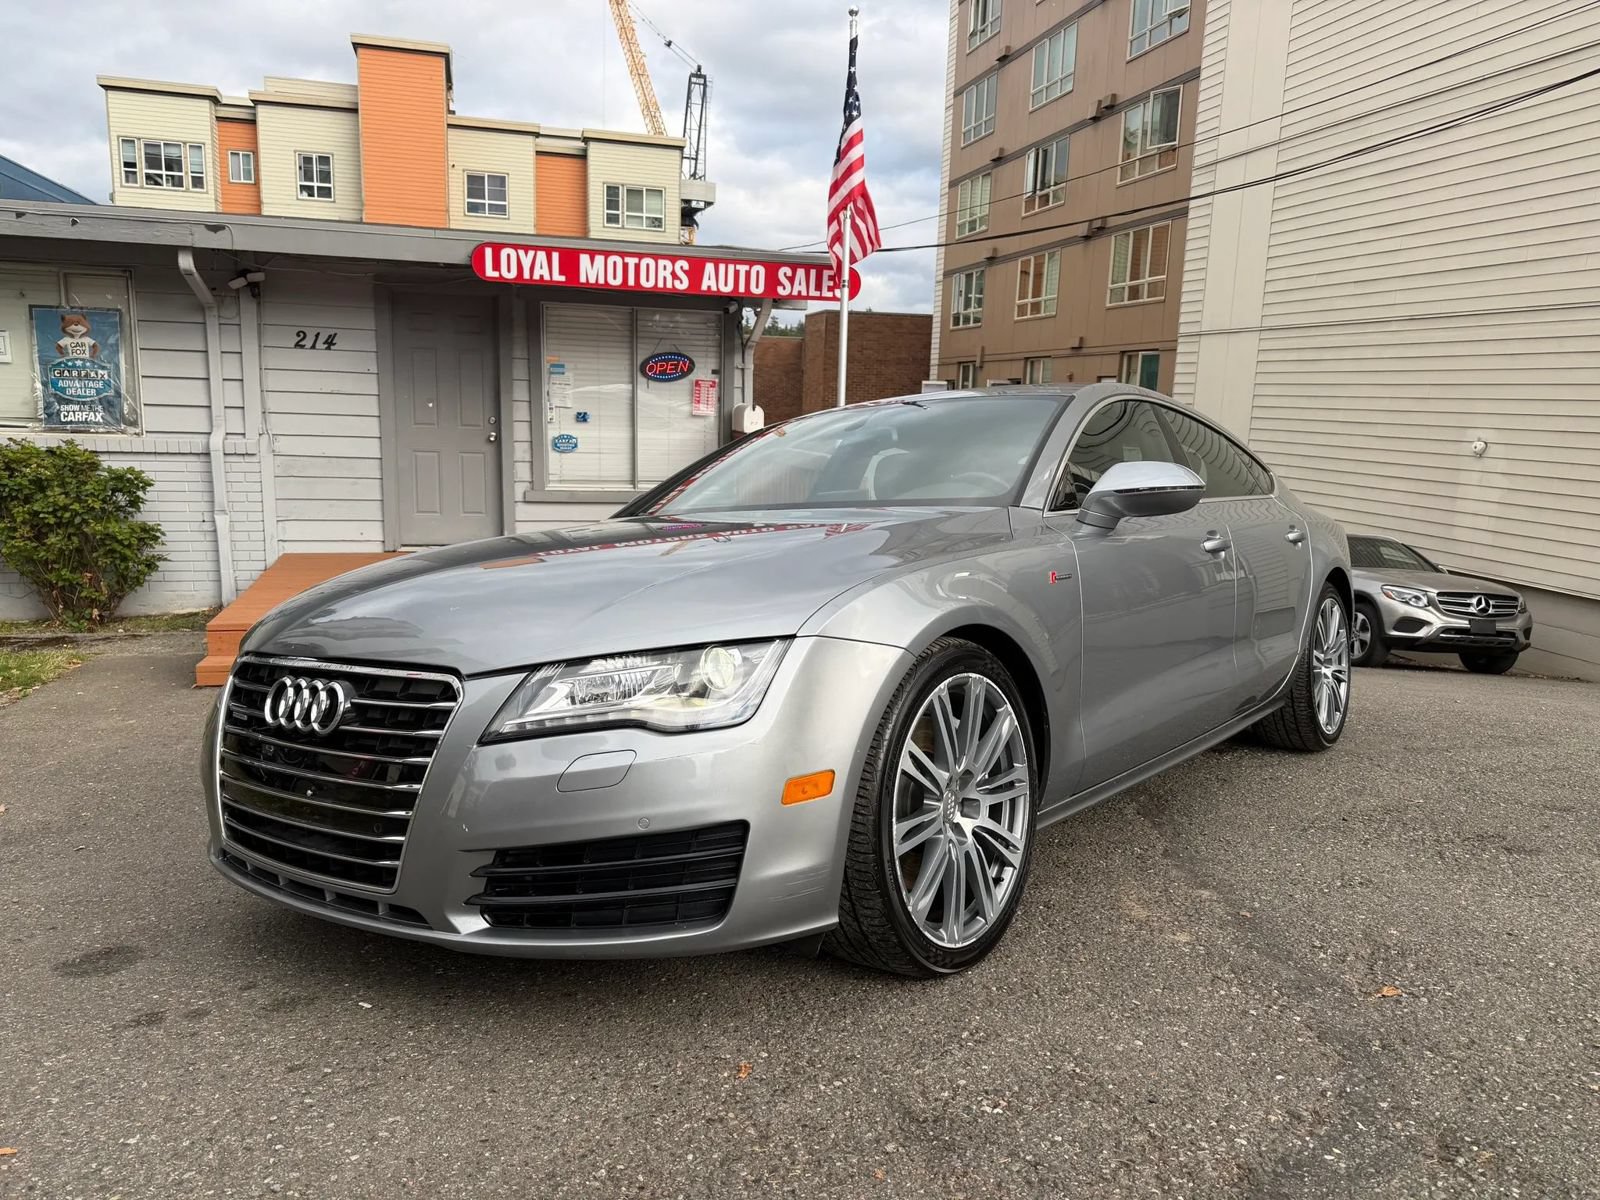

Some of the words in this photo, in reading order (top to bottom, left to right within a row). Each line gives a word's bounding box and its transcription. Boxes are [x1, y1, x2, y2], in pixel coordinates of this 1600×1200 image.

[484, 246, 566, 282] LOYAL
[579, 253, 690, 290] MOTORS
[700, 262, 766, 295] AUTO
[776, 266, 843, 299] SALE
[294, 330, 338, 350] 214
[69, 341, 87, 349] CAR
[71, 348, 87, 356] FOX
[646, 360, 690, 375] OPEN
[54, 370, 106, 379] CARFAX
[66, 388, 97, 396] DEALER
[60, 404, 80, 412] SHOW
[60, 411, 104, 422] CARFAX
